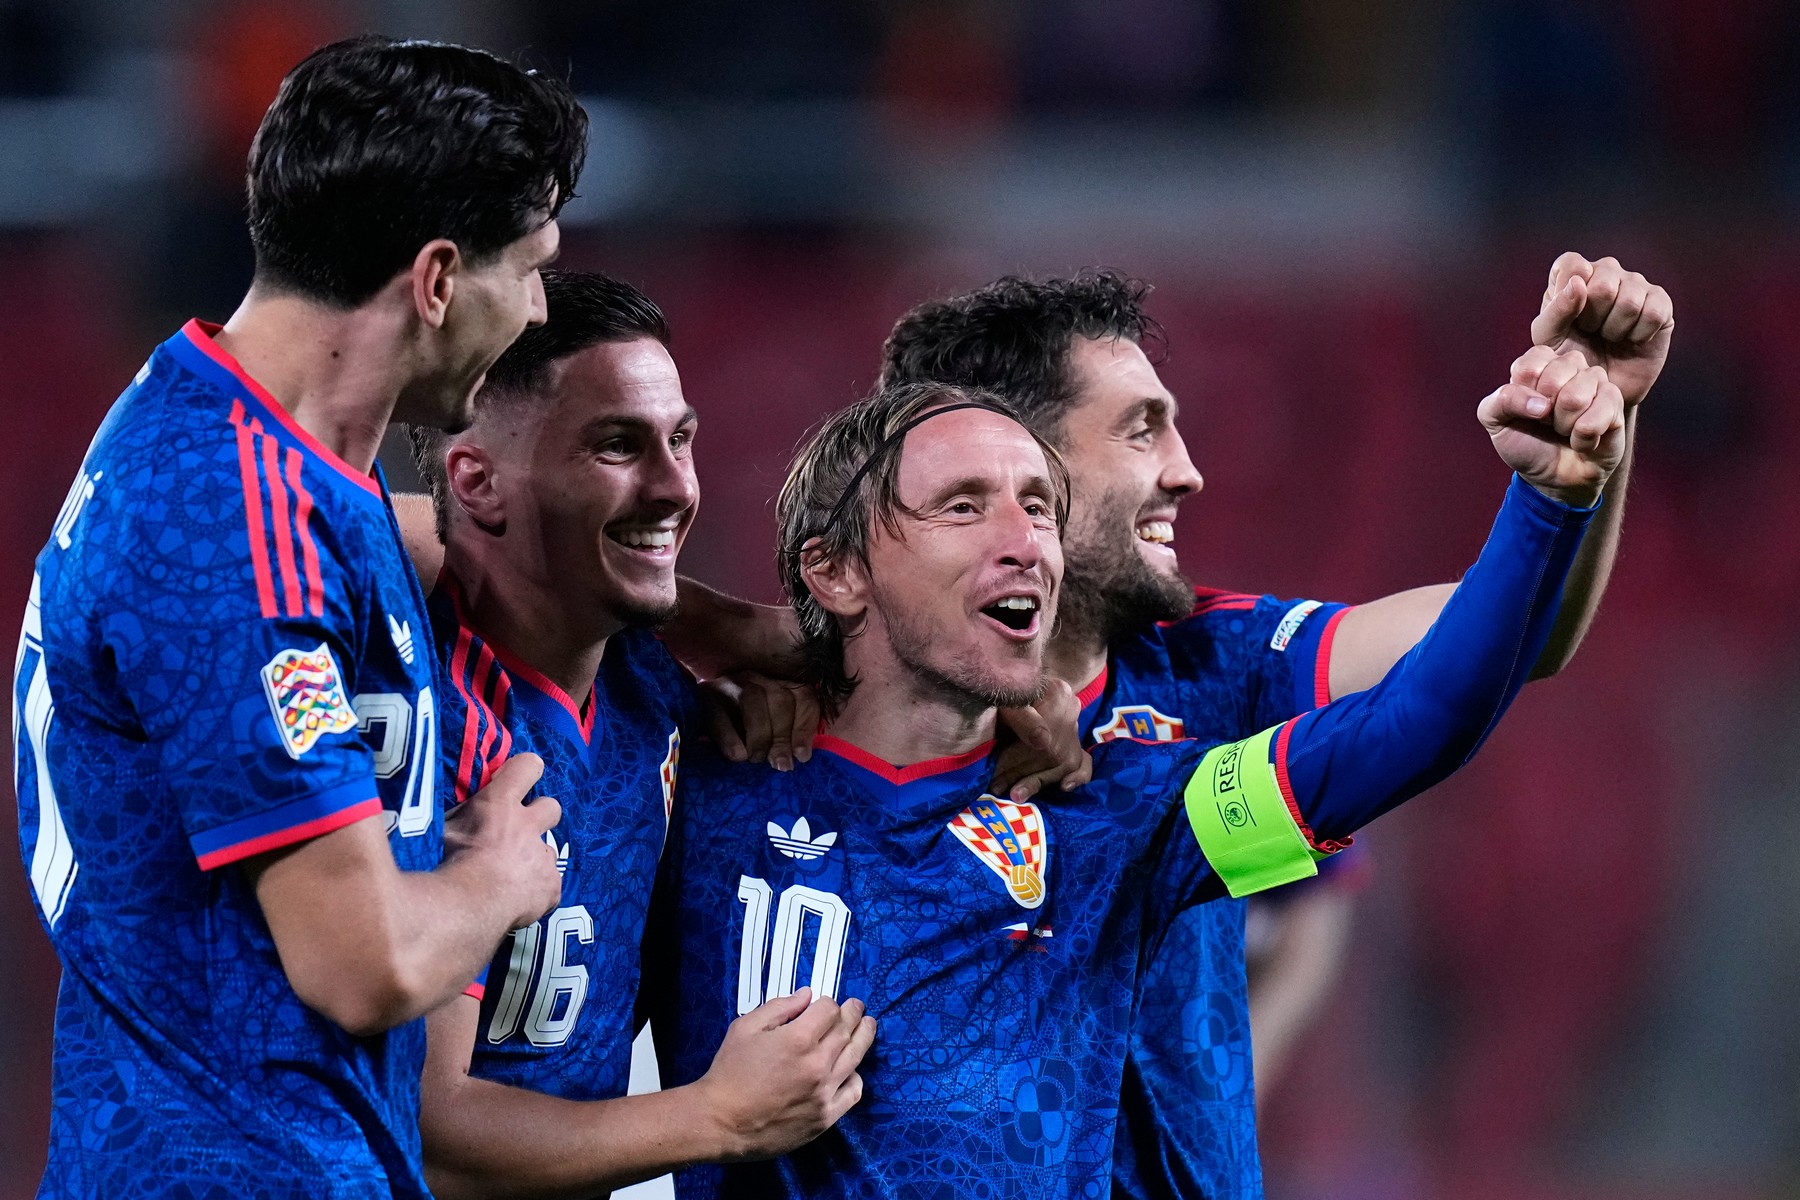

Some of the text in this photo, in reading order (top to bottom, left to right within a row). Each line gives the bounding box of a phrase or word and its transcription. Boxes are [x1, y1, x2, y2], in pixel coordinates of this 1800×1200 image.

[977, 806, 1018, 854] HNS
[488, 905, 594, 1047] 16
[737, 874, 851, 1016] 10
